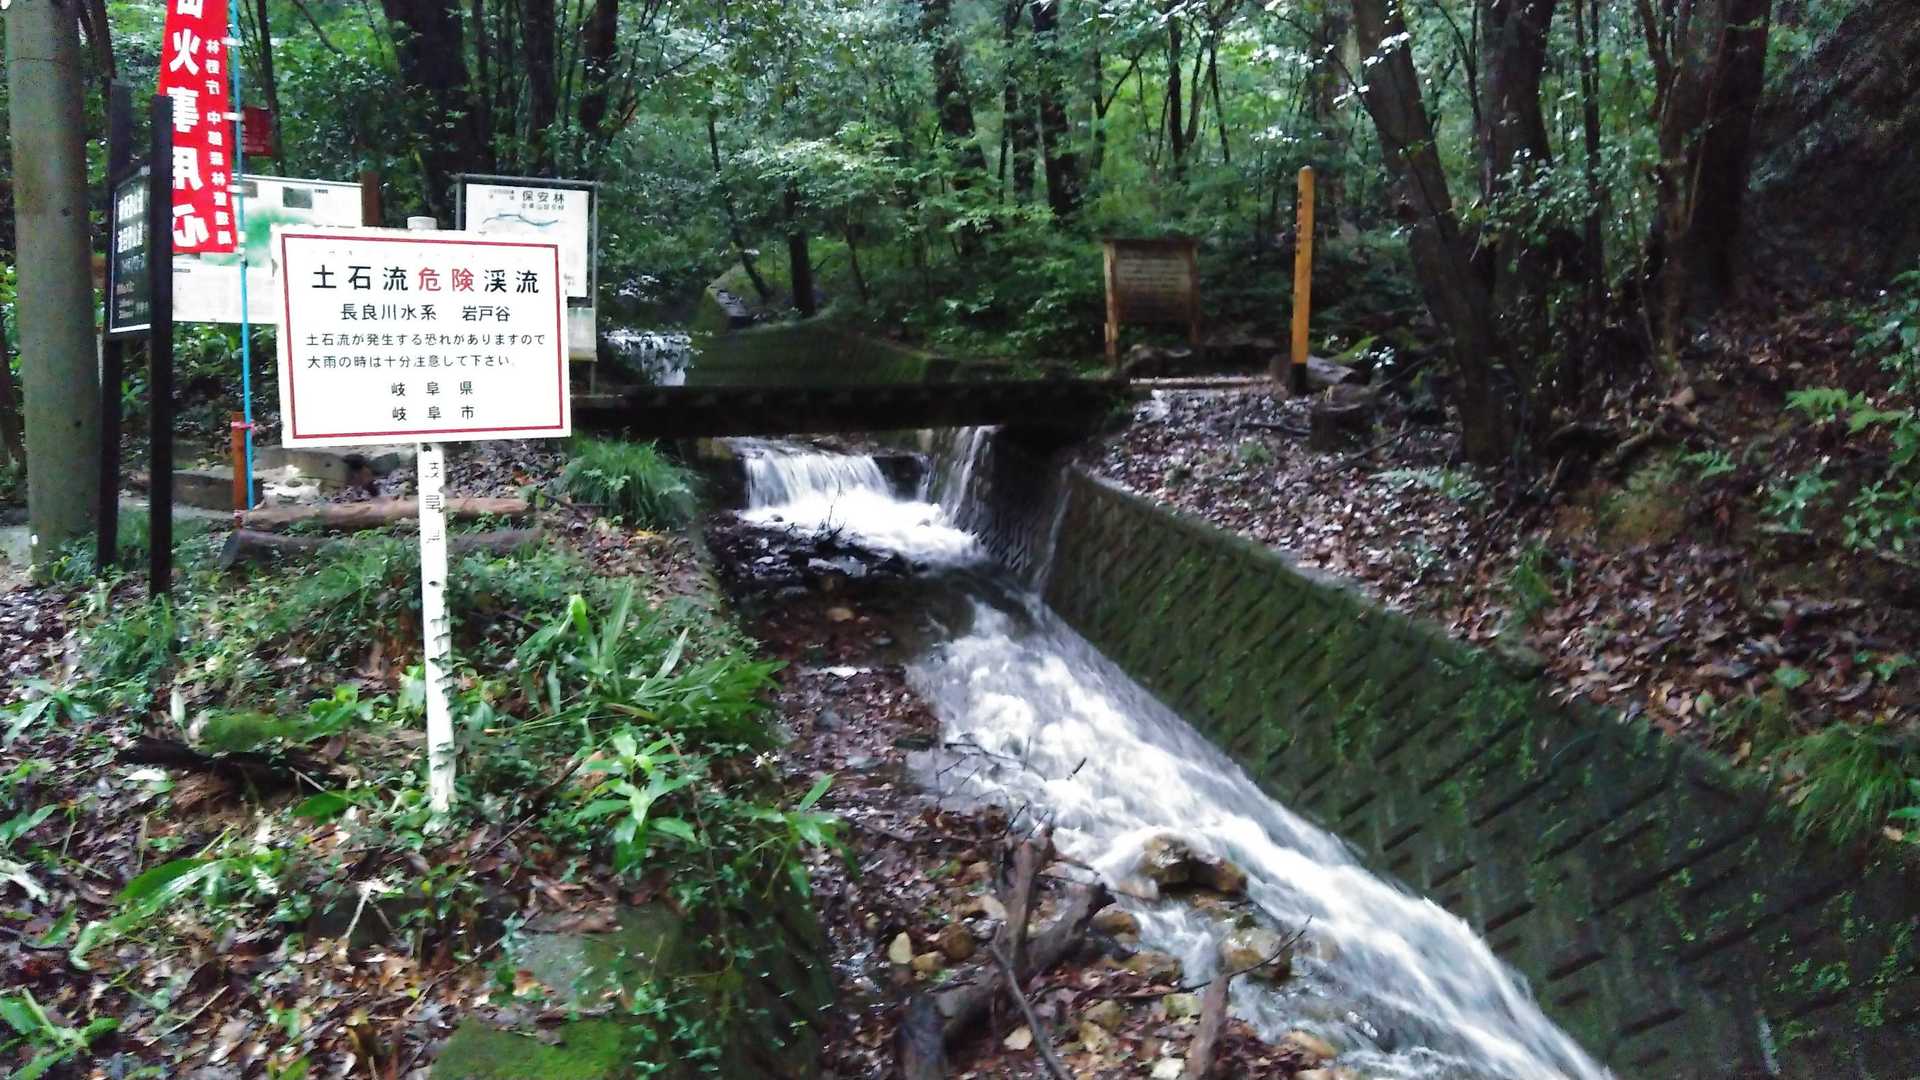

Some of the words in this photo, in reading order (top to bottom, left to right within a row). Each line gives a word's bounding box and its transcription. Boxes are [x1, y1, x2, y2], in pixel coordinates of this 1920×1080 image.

[522, 190, 565, 204] 保安林
[312, 264, 539, 293] 土石流危険渓流
[340, 303, 437, 321] 長良川水系
[461, 305, 511, 322] 岩戸谷
[305, 332, 545, 347] 土石流が発生する恐れがありますので
[391, 380, 474, 397] 岐阜県
[392, 405, 475, 421] 岐阜市
